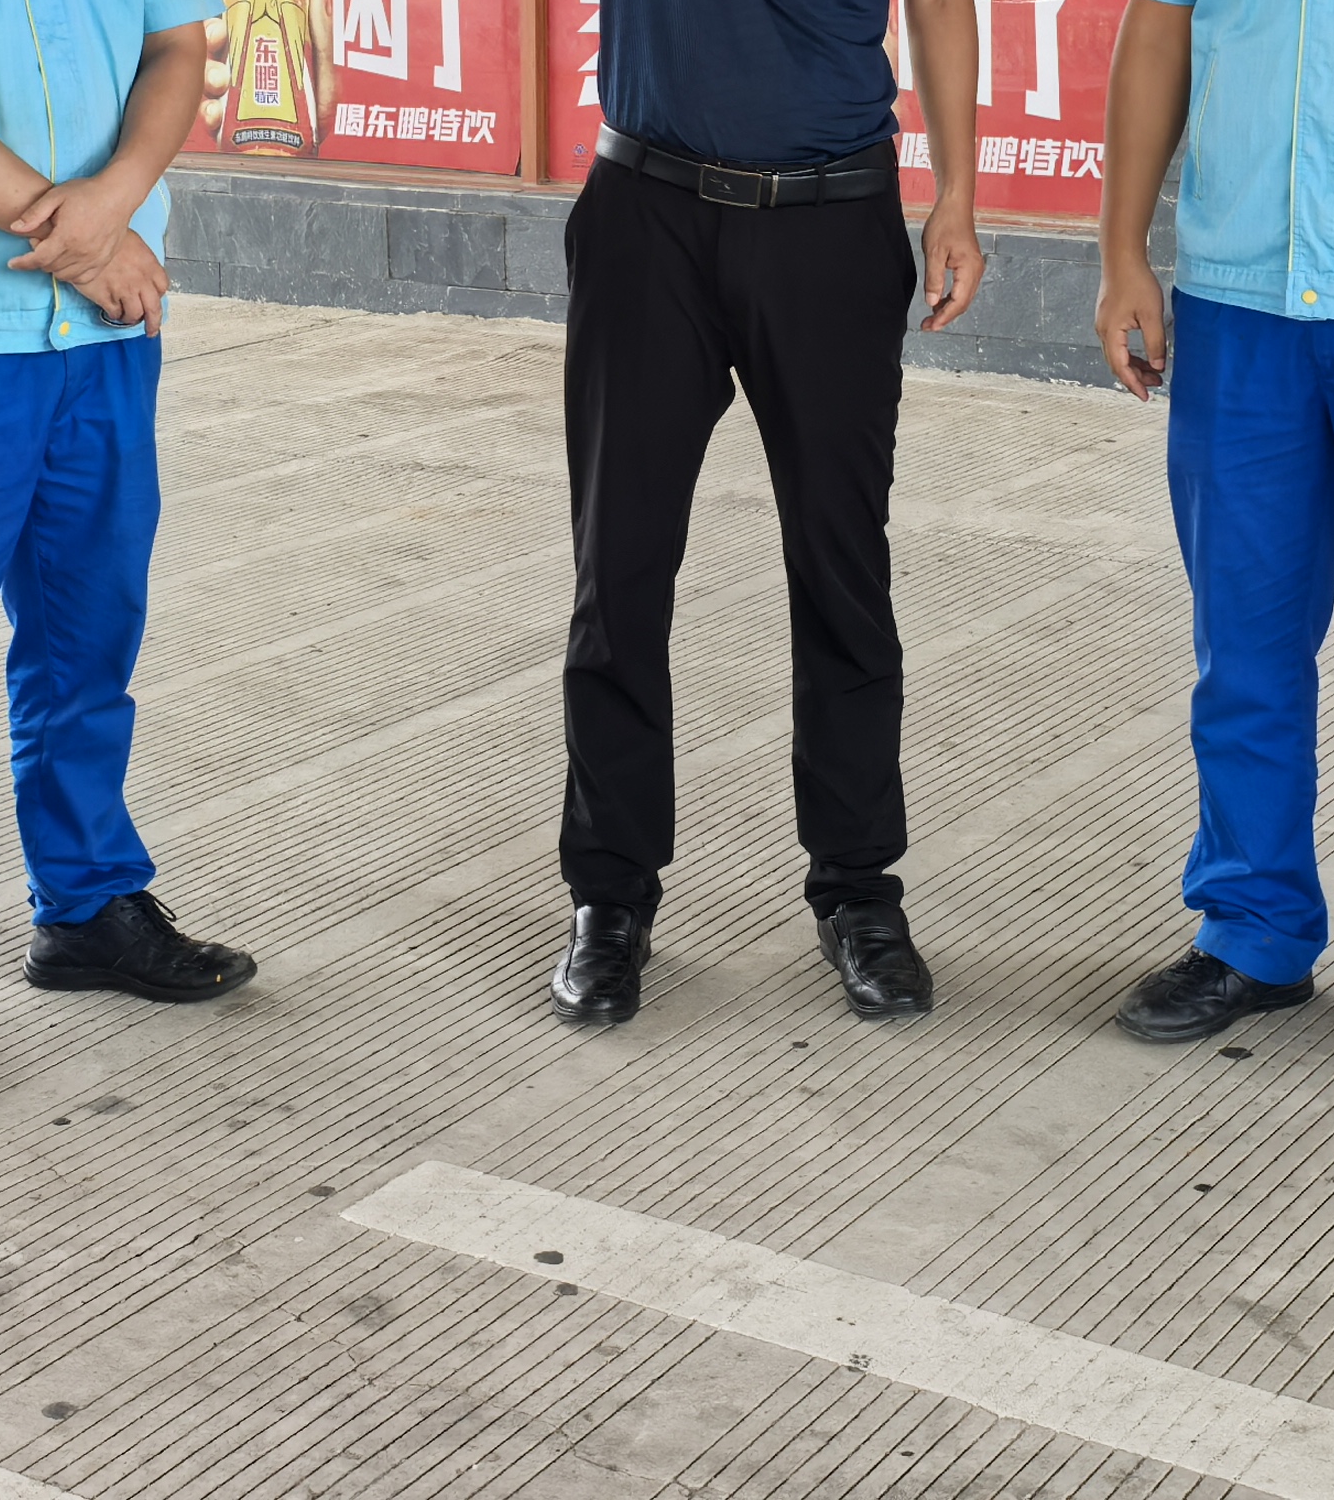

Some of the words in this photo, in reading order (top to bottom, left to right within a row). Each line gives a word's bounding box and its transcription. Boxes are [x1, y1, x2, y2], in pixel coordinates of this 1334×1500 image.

[333, 103, 497, 146] 喝东鹏特饮
[899, 132, 1104, 179] 喝鹏特饮
